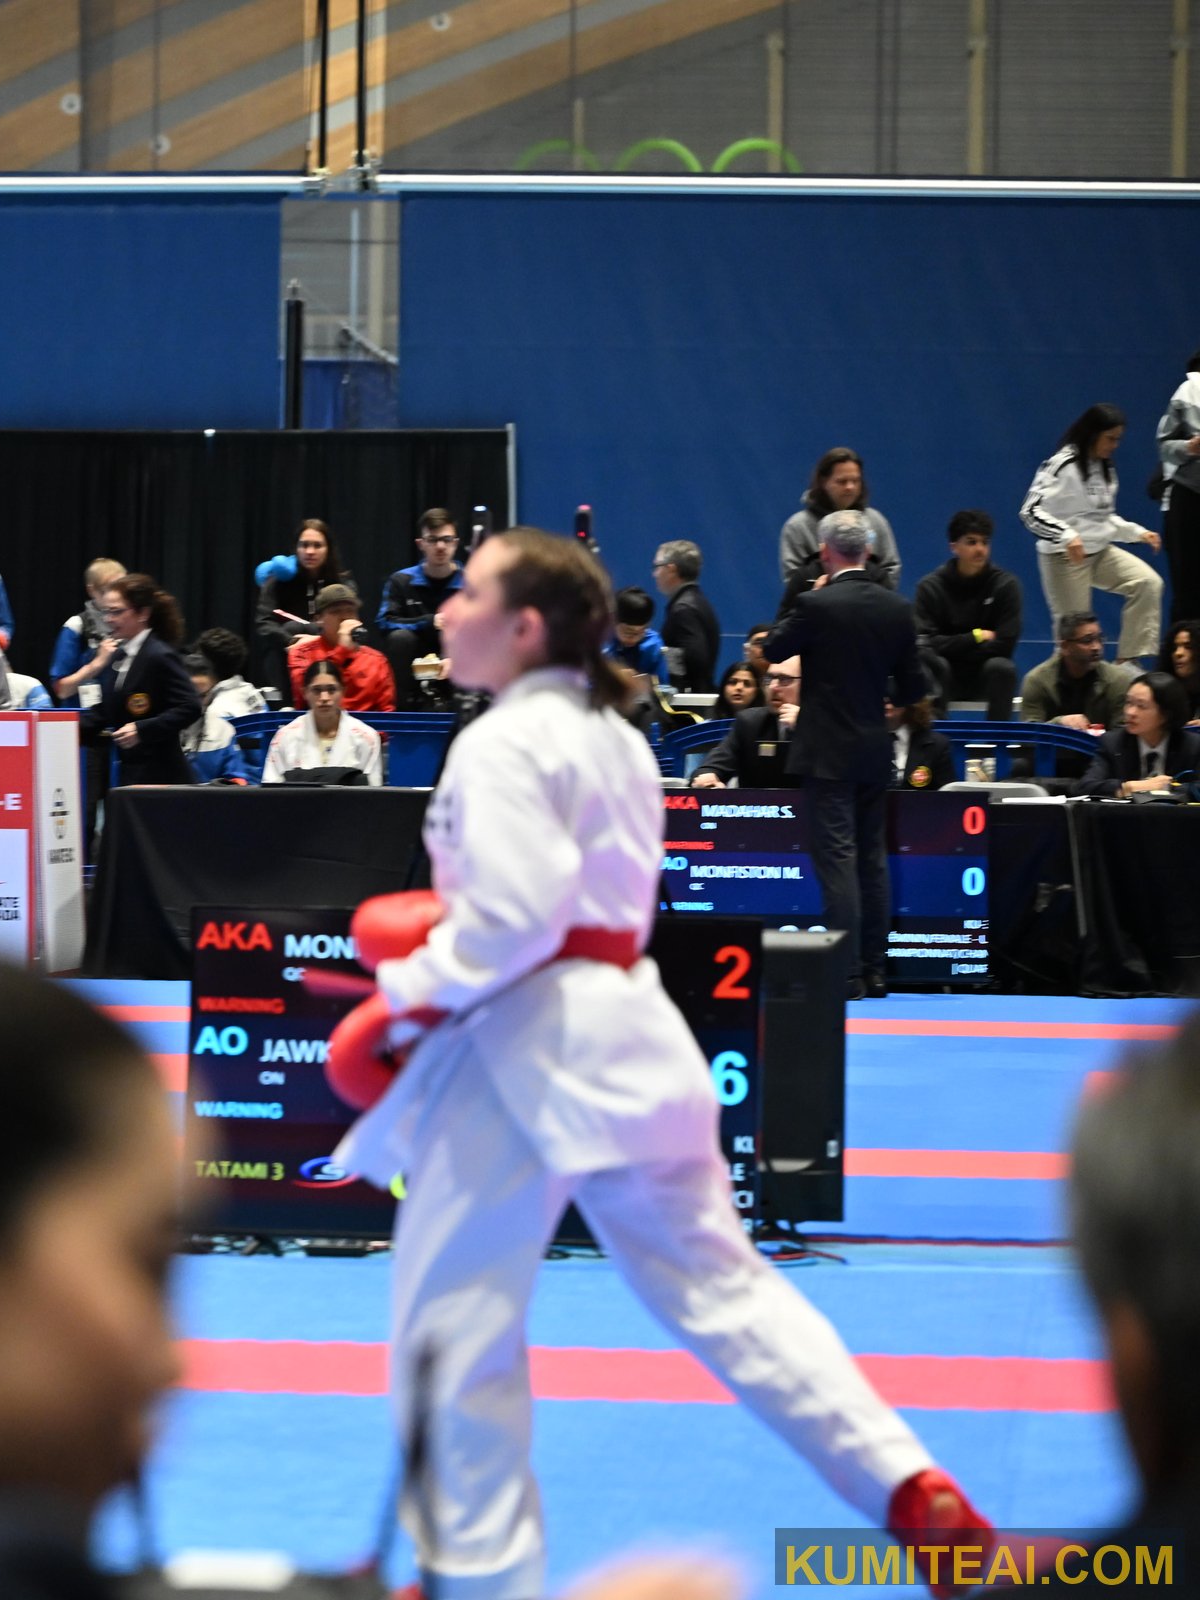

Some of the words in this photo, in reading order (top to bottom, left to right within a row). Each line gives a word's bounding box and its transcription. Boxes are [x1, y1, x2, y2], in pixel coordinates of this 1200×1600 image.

[963, 806, 986, 835] 0
[961, 867, 986, 896] 0
[197, 922, 272, 950] AKA
[284, 934, 360, 960] MON
[712, 945, 751, 999] 2
[194, 1025, 248, 1056] AO
[711, 1051, 749, 1106] 6
[194, 1101, 284, 1119] WARNING
[195, 1160, 268, 1179] TATAMI
[271, 1162, 285, 1181] 3
